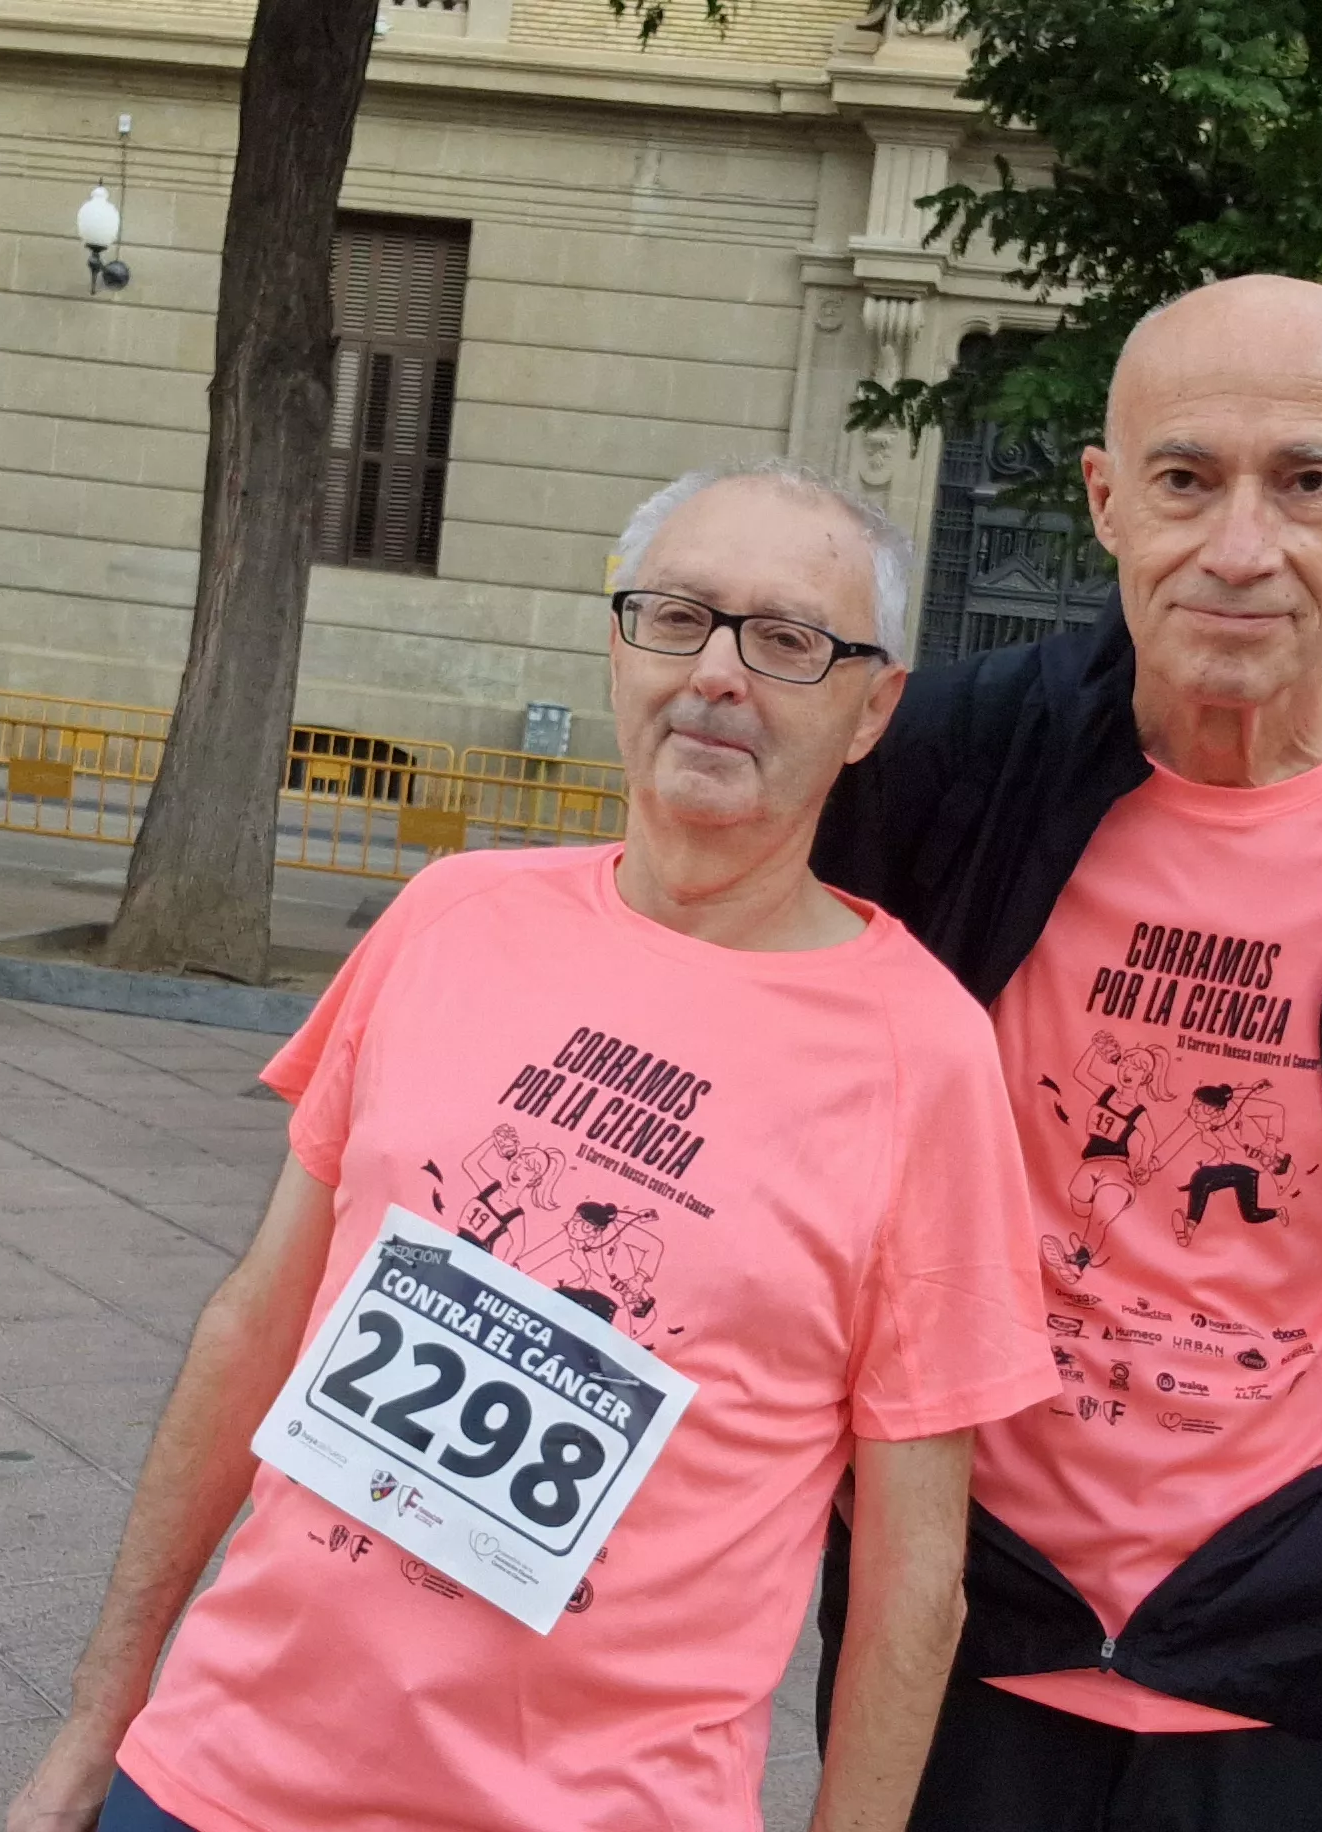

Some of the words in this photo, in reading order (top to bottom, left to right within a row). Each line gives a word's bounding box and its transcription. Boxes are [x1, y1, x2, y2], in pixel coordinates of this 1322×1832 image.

[1125, 921, 1281, 990] CORRAMOS
[1085, 967, 1144, 1020] POR
[1142, 976, 1178, 1026] LA
[1179, 983, 1292, 1046] CIENCIA
[552, 1026, 712, 1121] CORRAMOS
[1187, 1036, 1221, 1055] Carrera
[1222, 1042, 1252, 1061] Huesca
[1253, 1051, 1281, 1066] contra
[1283, 1053, 1291, 1067] el
[497, 1064, 567, 1118] POR
[550, 1081, 599, 1131] LA
[585, 1097, 705, 1180] CIENCIA
[1096, 1112, 1115, 1135] 19
[585, 1147, 620, 1173] Carrera
[618, 1161, 649, 1186] Huesca
[647, 1177, 677, 1200] contra
[675, 1190, 688, 1204] el
[469, 1207, 490, 1232] 19
[395, 1243, 445, 1266] EDICIÓN
[473, 1290, 554, 1348] HUESCA
[1115, 1326, 1162, 1342] Humeco
[1173, 1336, 1224, 1355] URBAN
[381, 1268, 485, 1339] CONTRA
[484, 1321, 514, 1359] EL
[520, 1348, 633, 1430] CÁNCER
[319, 1309, 606, 1528] 2298
